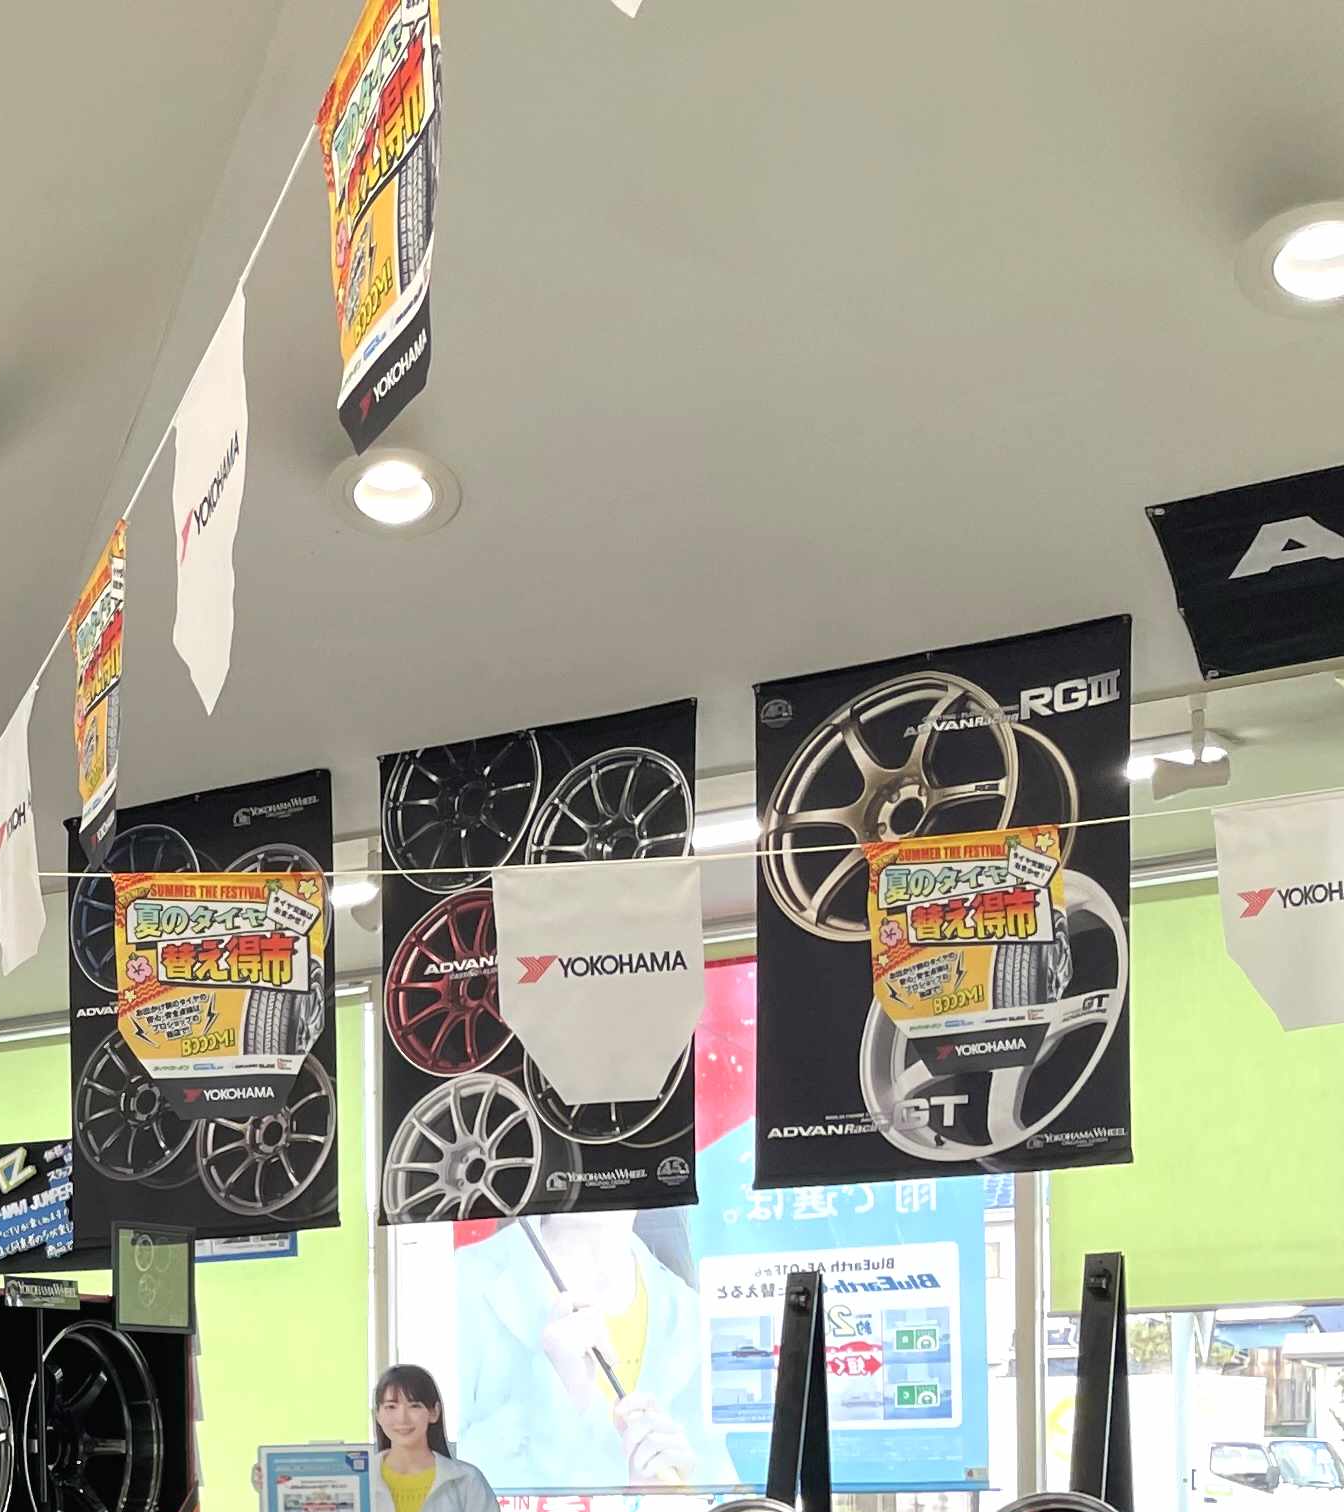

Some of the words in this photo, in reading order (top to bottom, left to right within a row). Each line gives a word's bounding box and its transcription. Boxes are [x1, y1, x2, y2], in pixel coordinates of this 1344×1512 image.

[373, 328, 427, 403] YOKOHAMA
[193, 431, 241, 535] YOKOHAMA
[149, 883, 197, 899] SUMMER
[199, 885, 218, 899] THE
[1277, 881, 1344, 909] YOKOH
[910, 886, 1040, 940] 替え得市
[162, 931, 300, 985] 替え得市
[557, 950, 687, 978] YOKOHAMA
[955, 1037, 1027, 1057] YOKOHAMA
[203, 1086, 275, 1101] YOKOHAMA
[894, 1094, 969, 1131] GT
[767, 1124, 845, 1139] ADVAN
